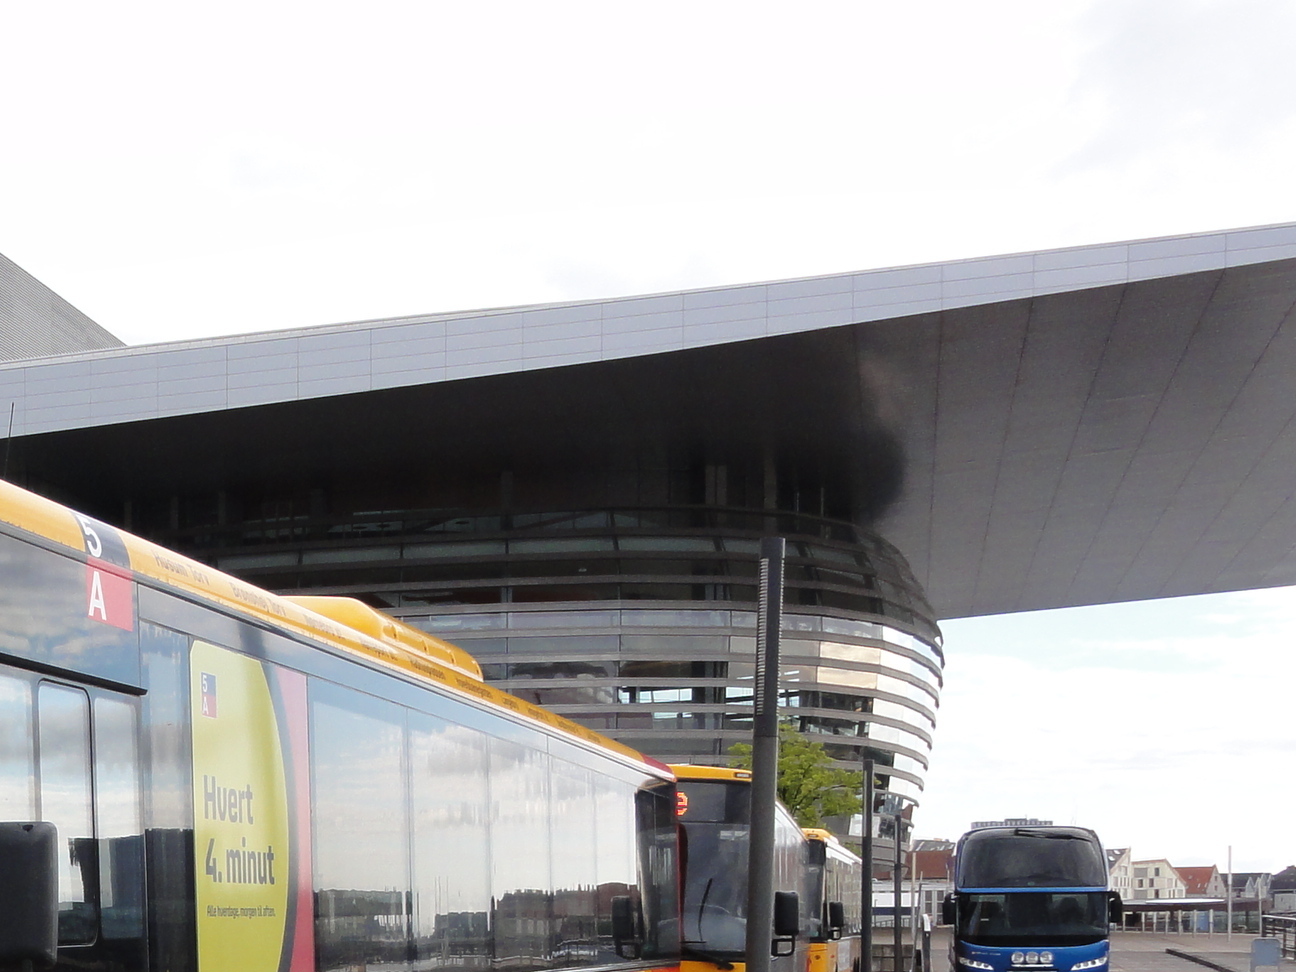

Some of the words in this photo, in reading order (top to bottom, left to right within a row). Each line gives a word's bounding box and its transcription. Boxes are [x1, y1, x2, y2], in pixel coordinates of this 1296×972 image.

[75, 513, 103, 558] 5
[88, 571, 107, 621] A
[203, 775, 253, 825] Hvert
[205, 838, 222, 884] 4.
[226, 837, 275, 885] minut
